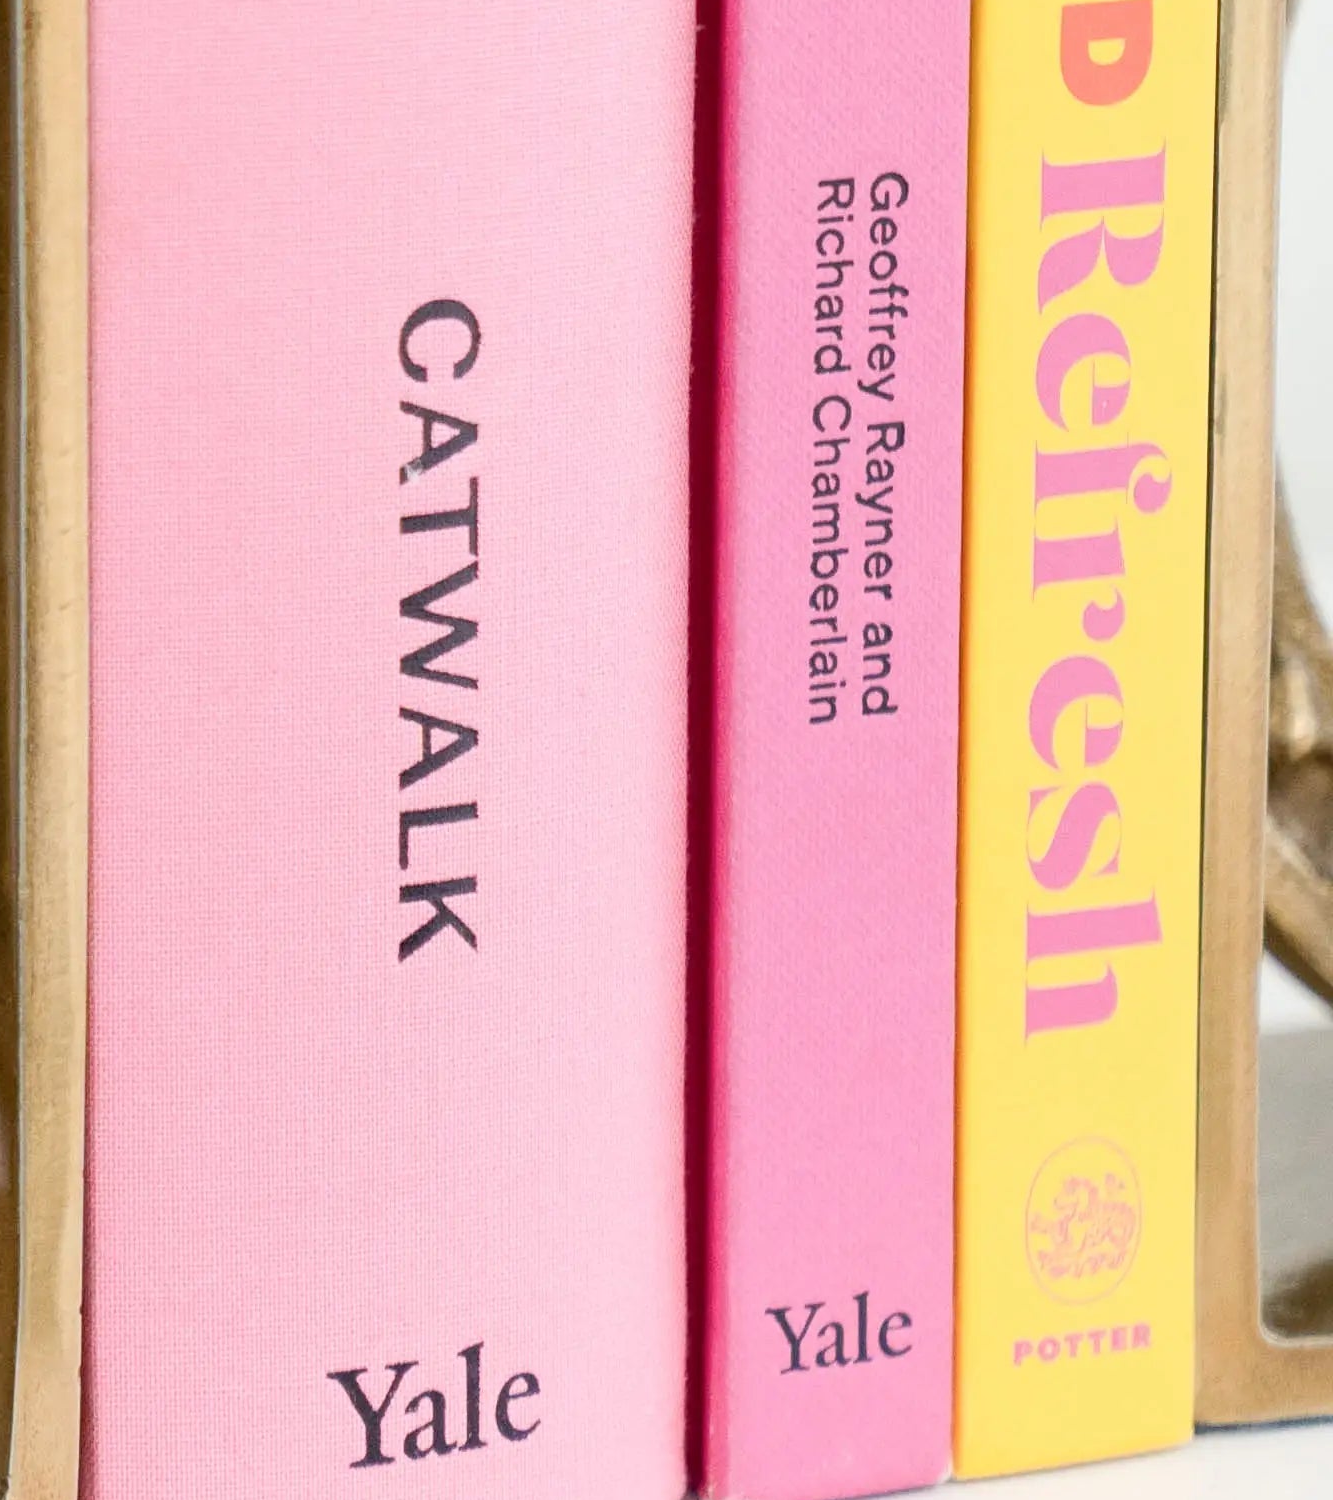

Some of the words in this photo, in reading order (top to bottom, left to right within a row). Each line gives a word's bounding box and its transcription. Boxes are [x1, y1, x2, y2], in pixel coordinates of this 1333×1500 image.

[814, 178, 855, 374] Richard
[857, 171, 910, 402] Geoffrey
[809, 395, 852, 724] Chamberlain
[854, 420, 906, 601] Rayner
[1023, 147, 1173, 1039] Refresh
[398, 299, 481, 961] CATWALK
[862, 623, 898, 715] and
[327, 1342, 540, 1468] Yale
[766, 1292, 911, 1373] Yale
[1012, 1321, 1151, 1365] POTTER
